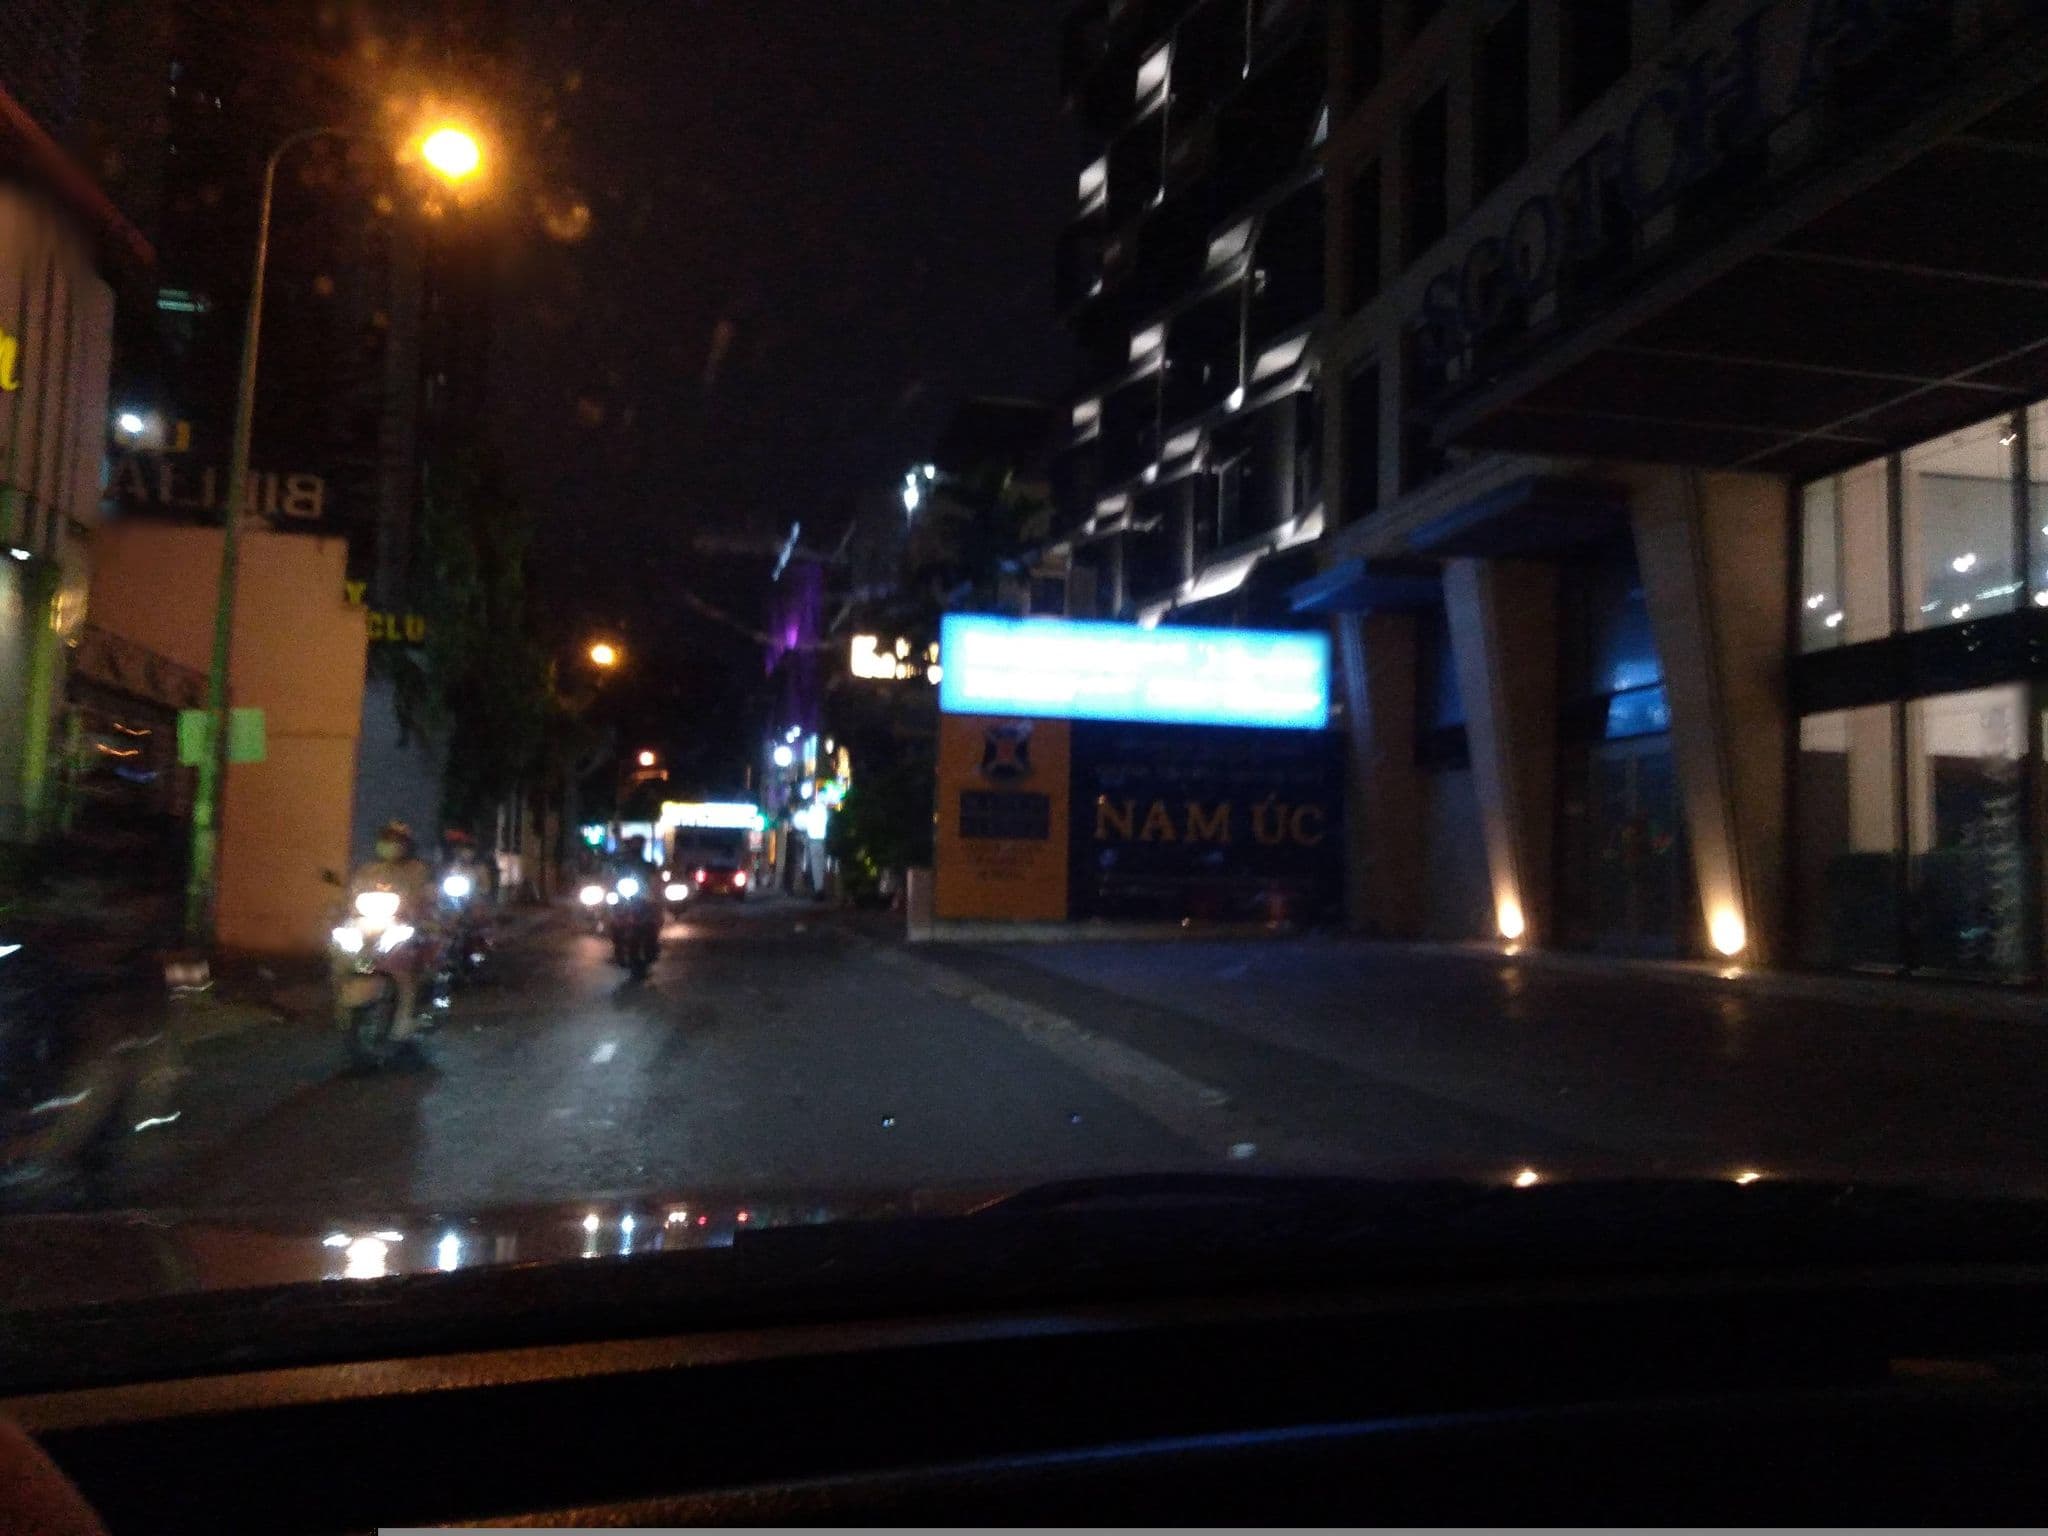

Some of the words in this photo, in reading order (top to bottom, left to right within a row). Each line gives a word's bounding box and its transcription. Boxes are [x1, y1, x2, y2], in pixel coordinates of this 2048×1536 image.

[1418, 8, 1770, 370] SCOTCH
[1093, 796, 1233, 844] NAM
[1250, 791, 1326, 847] ÚC
